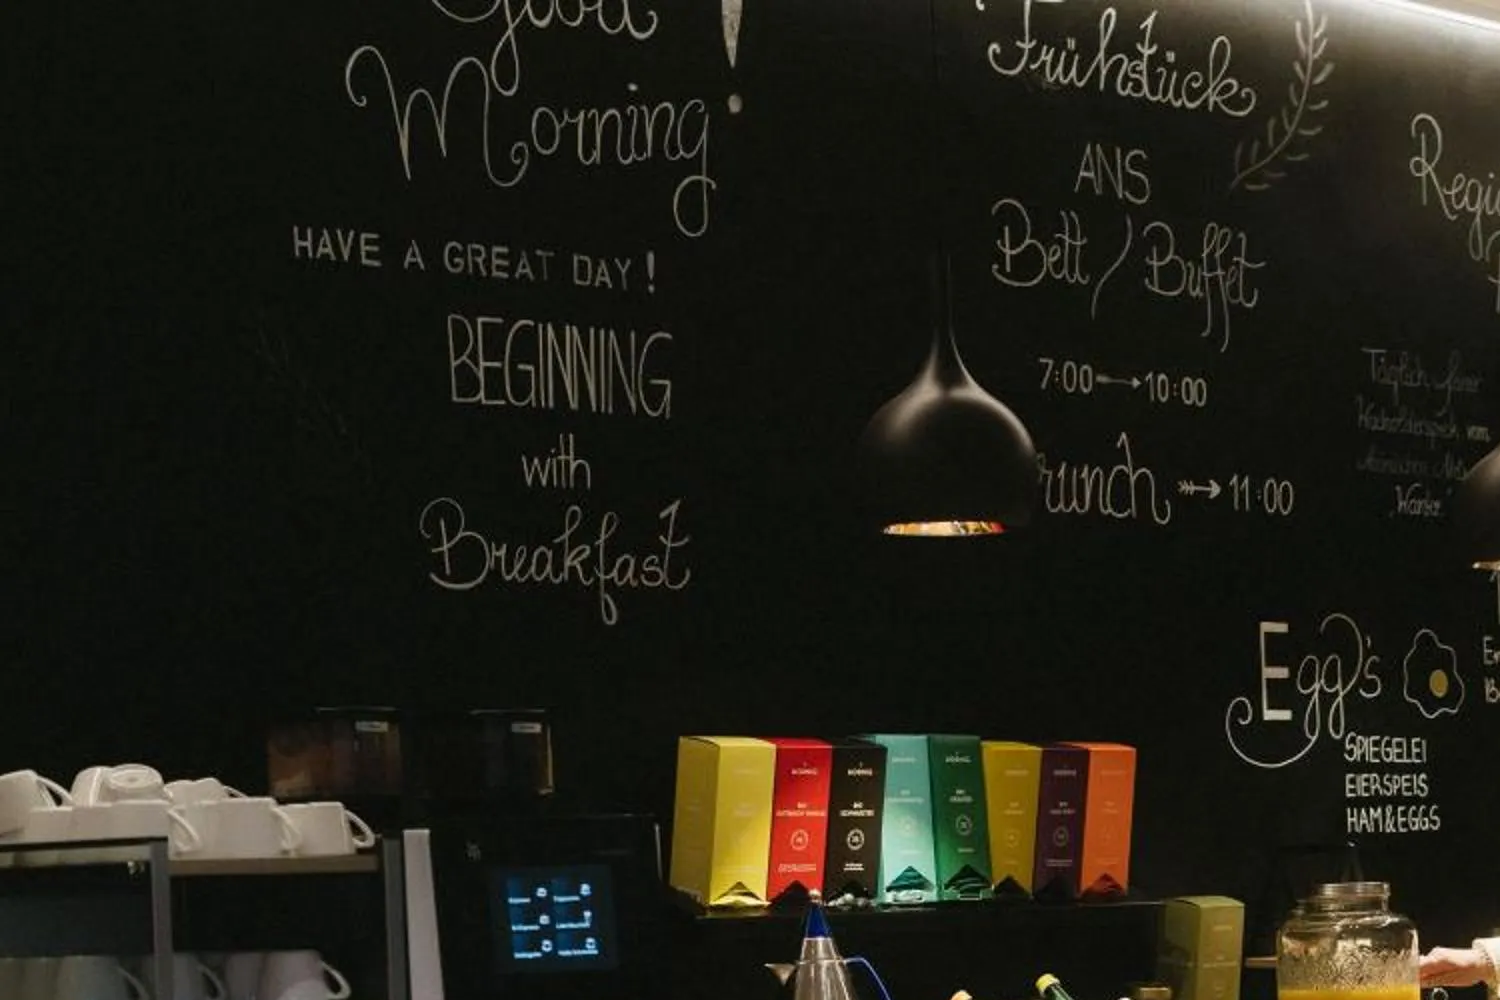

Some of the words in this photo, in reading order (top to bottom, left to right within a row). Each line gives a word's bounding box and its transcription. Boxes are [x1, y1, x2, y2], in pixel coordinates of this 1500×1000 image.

[345, 45, 716, 237] Morning
[1074, 143, 1150, 205] ANS
[292, 226, 382, 268] HAVE
[403, 240, 425, 272] A
[443, 241, 555, 282] GREAT
[992, 198, 1090, 287] Bett
[1143, 220, 1267, 353] Buffet
[447, 314, 673, 419] BEGINNING
[1038, 357, 1094, 395] 7:00
[1144, 372, 1208, 408] 10:00
[521, 432, 592, 490] with
[1229, 474, 1295, 516] 11:00
[419, 497, 692, 625] Breakfast
[1344, 731, 1427, 764] SPIEGELEI
[1345, 772, 1429, 798] EIERSPEIS
[1346, 804, 1441, 833] HAM&EGGS
